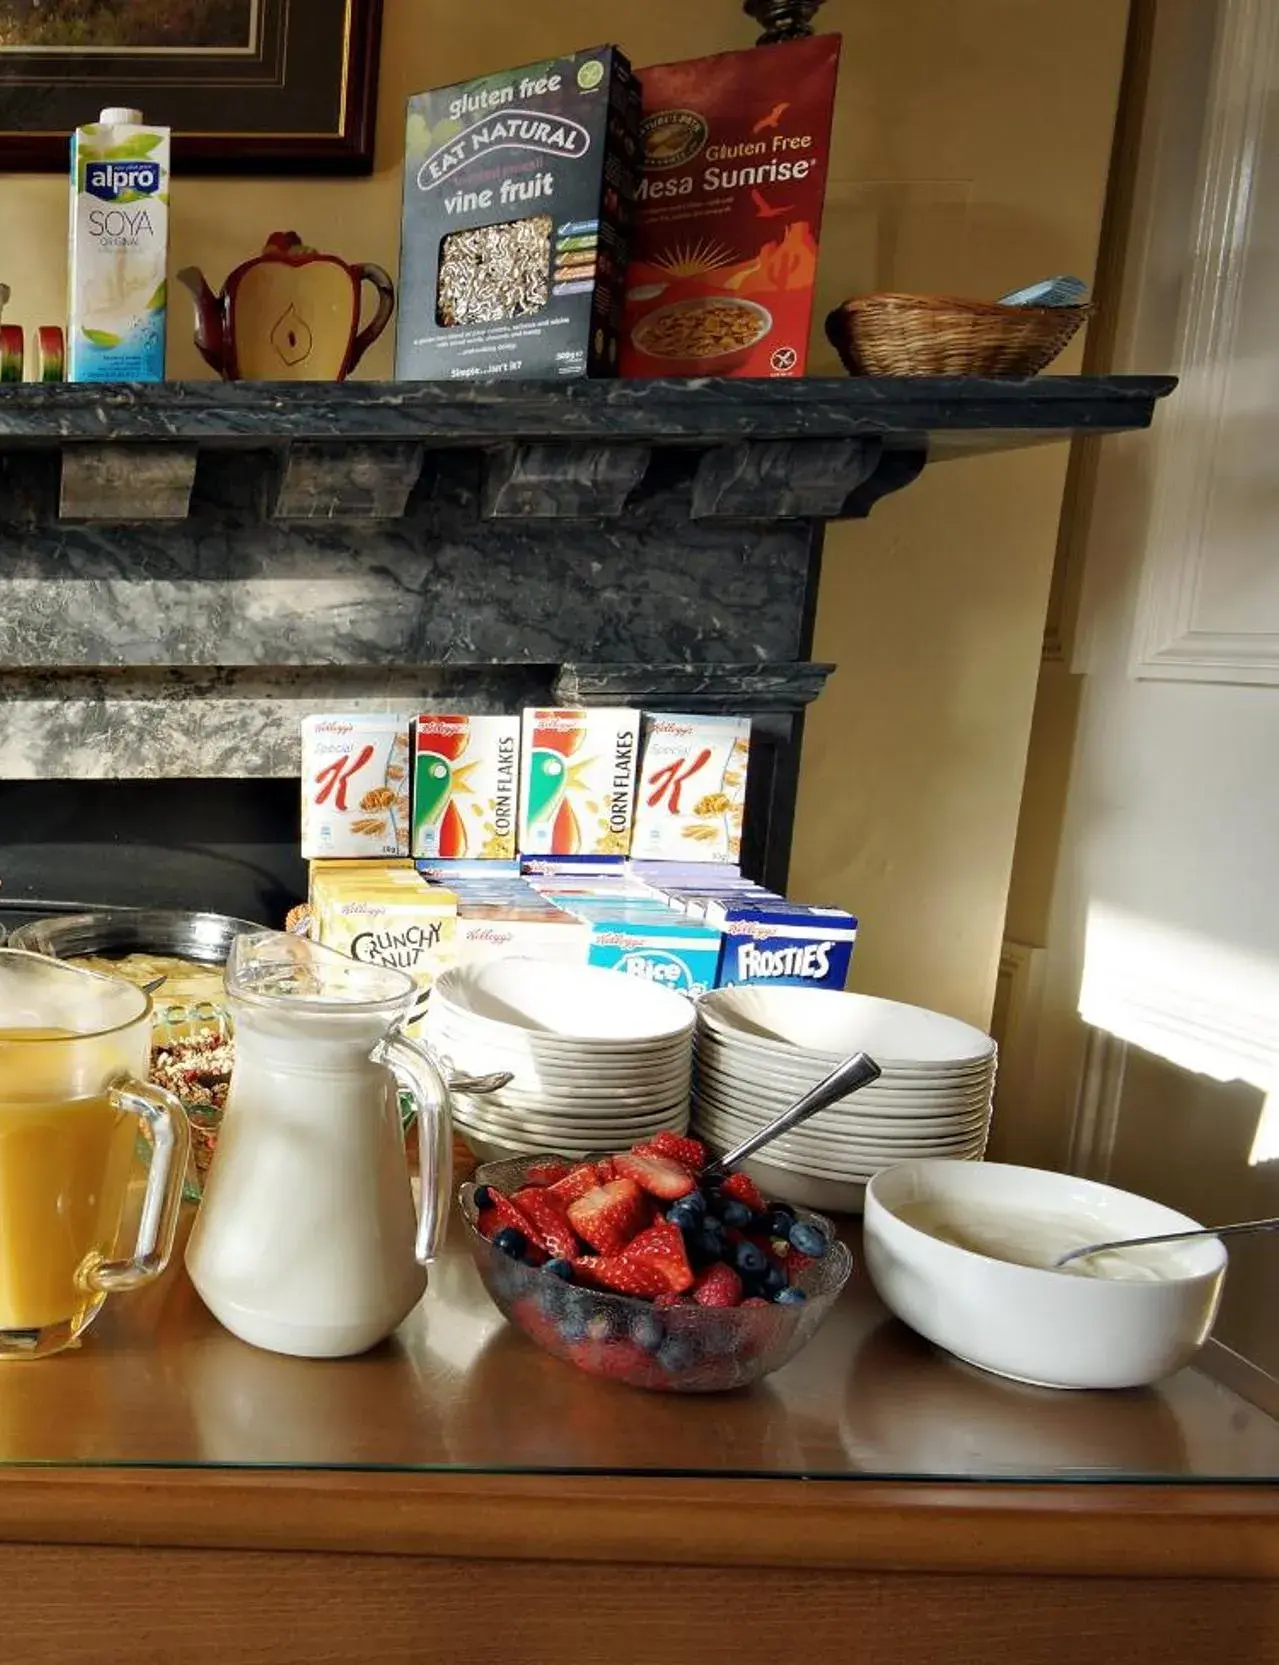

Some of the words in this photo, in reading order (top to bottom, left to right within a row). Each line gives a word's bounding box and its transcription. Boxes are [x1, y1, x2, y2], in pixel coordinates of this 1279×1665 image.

[449, 86, 514, 120] gluten
[519, 73, 562, 99] free
[428, 141, 467, 178] EAT
[471, 119, 578, 151] NATURAL
[705, 141, 766, 162] Gluten
[772, 135, 812, 151] Free
[91, 164, 155, 195] alpro
[444, 190, 494, 215] vine
[499, 171, 555, 204] fruit
[703, 158, 810, 192] Sunrise
[89, 210, 154, 237] SOYA
[315, 745, 374, 811] K
[497, 736, 515, 794] FLAKES
[613, 730, 634, 789] FLAKES
[647, 749, 711, 814] K
[495, 795, 512, 838] CORN
[609, 791, 629, 835] CORN
[350, 920, 443, 962] CRUNCHY
[380, 947, 426, 969] NUT
[738, 942, 834, 981] FROSTIES
[626, 956, 682, 982] Rice
